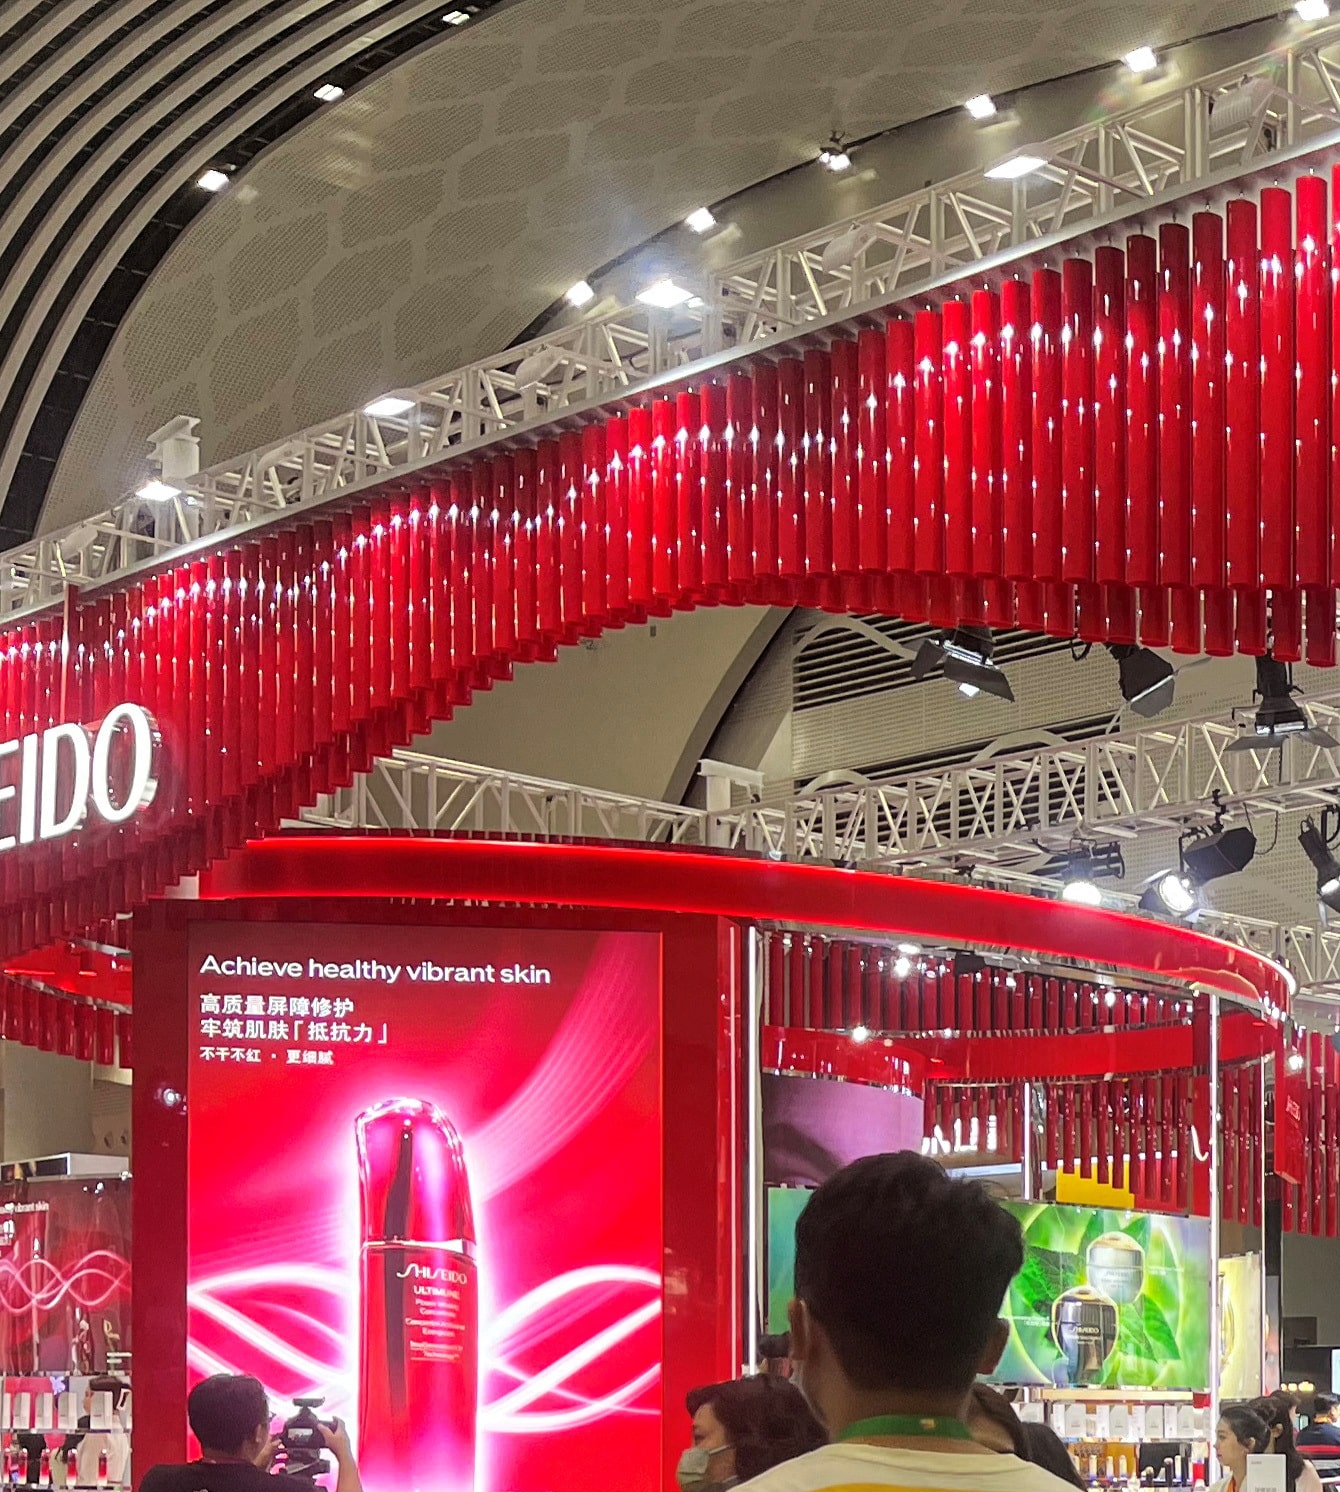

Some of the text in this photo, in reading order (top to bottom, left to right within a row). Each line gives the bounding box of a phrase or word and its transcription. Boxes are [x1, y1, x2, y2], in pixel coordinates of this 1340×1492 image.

[200, 954, 552, 985] Achieve healthy vibrant skin
[200, 993, 355, 1019] 高质量屏障修护
[396, 1263, 468, 1285] SHISEIDO
